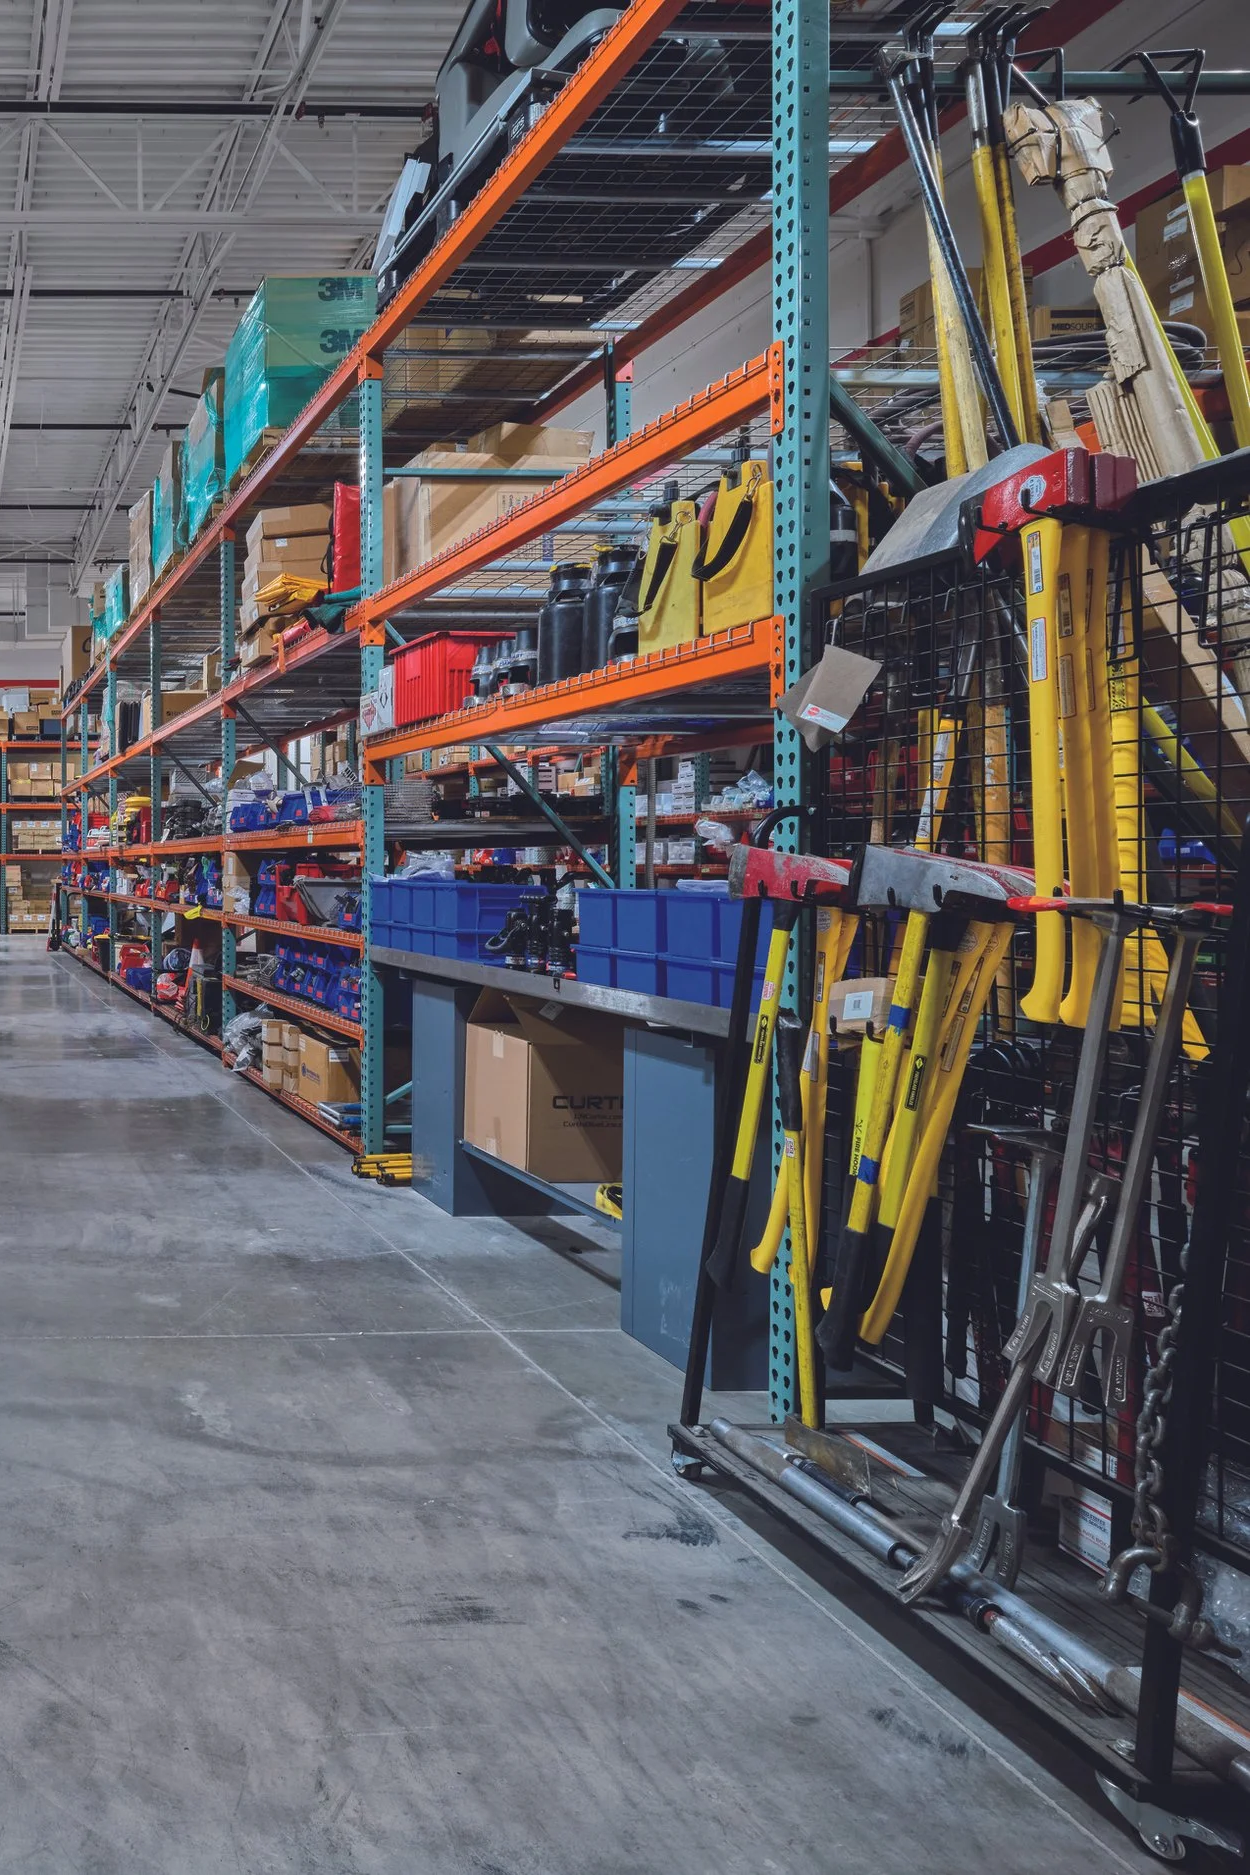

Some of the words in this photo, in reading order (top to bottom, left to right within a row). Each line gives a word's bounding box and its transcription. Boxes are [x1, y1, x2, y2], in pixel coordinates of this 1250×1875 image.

[318, 278, 363, 302] 3M
[1052, 323, 1101, 331] MEDSOURC
[320, 329, 365, 353] 3M
